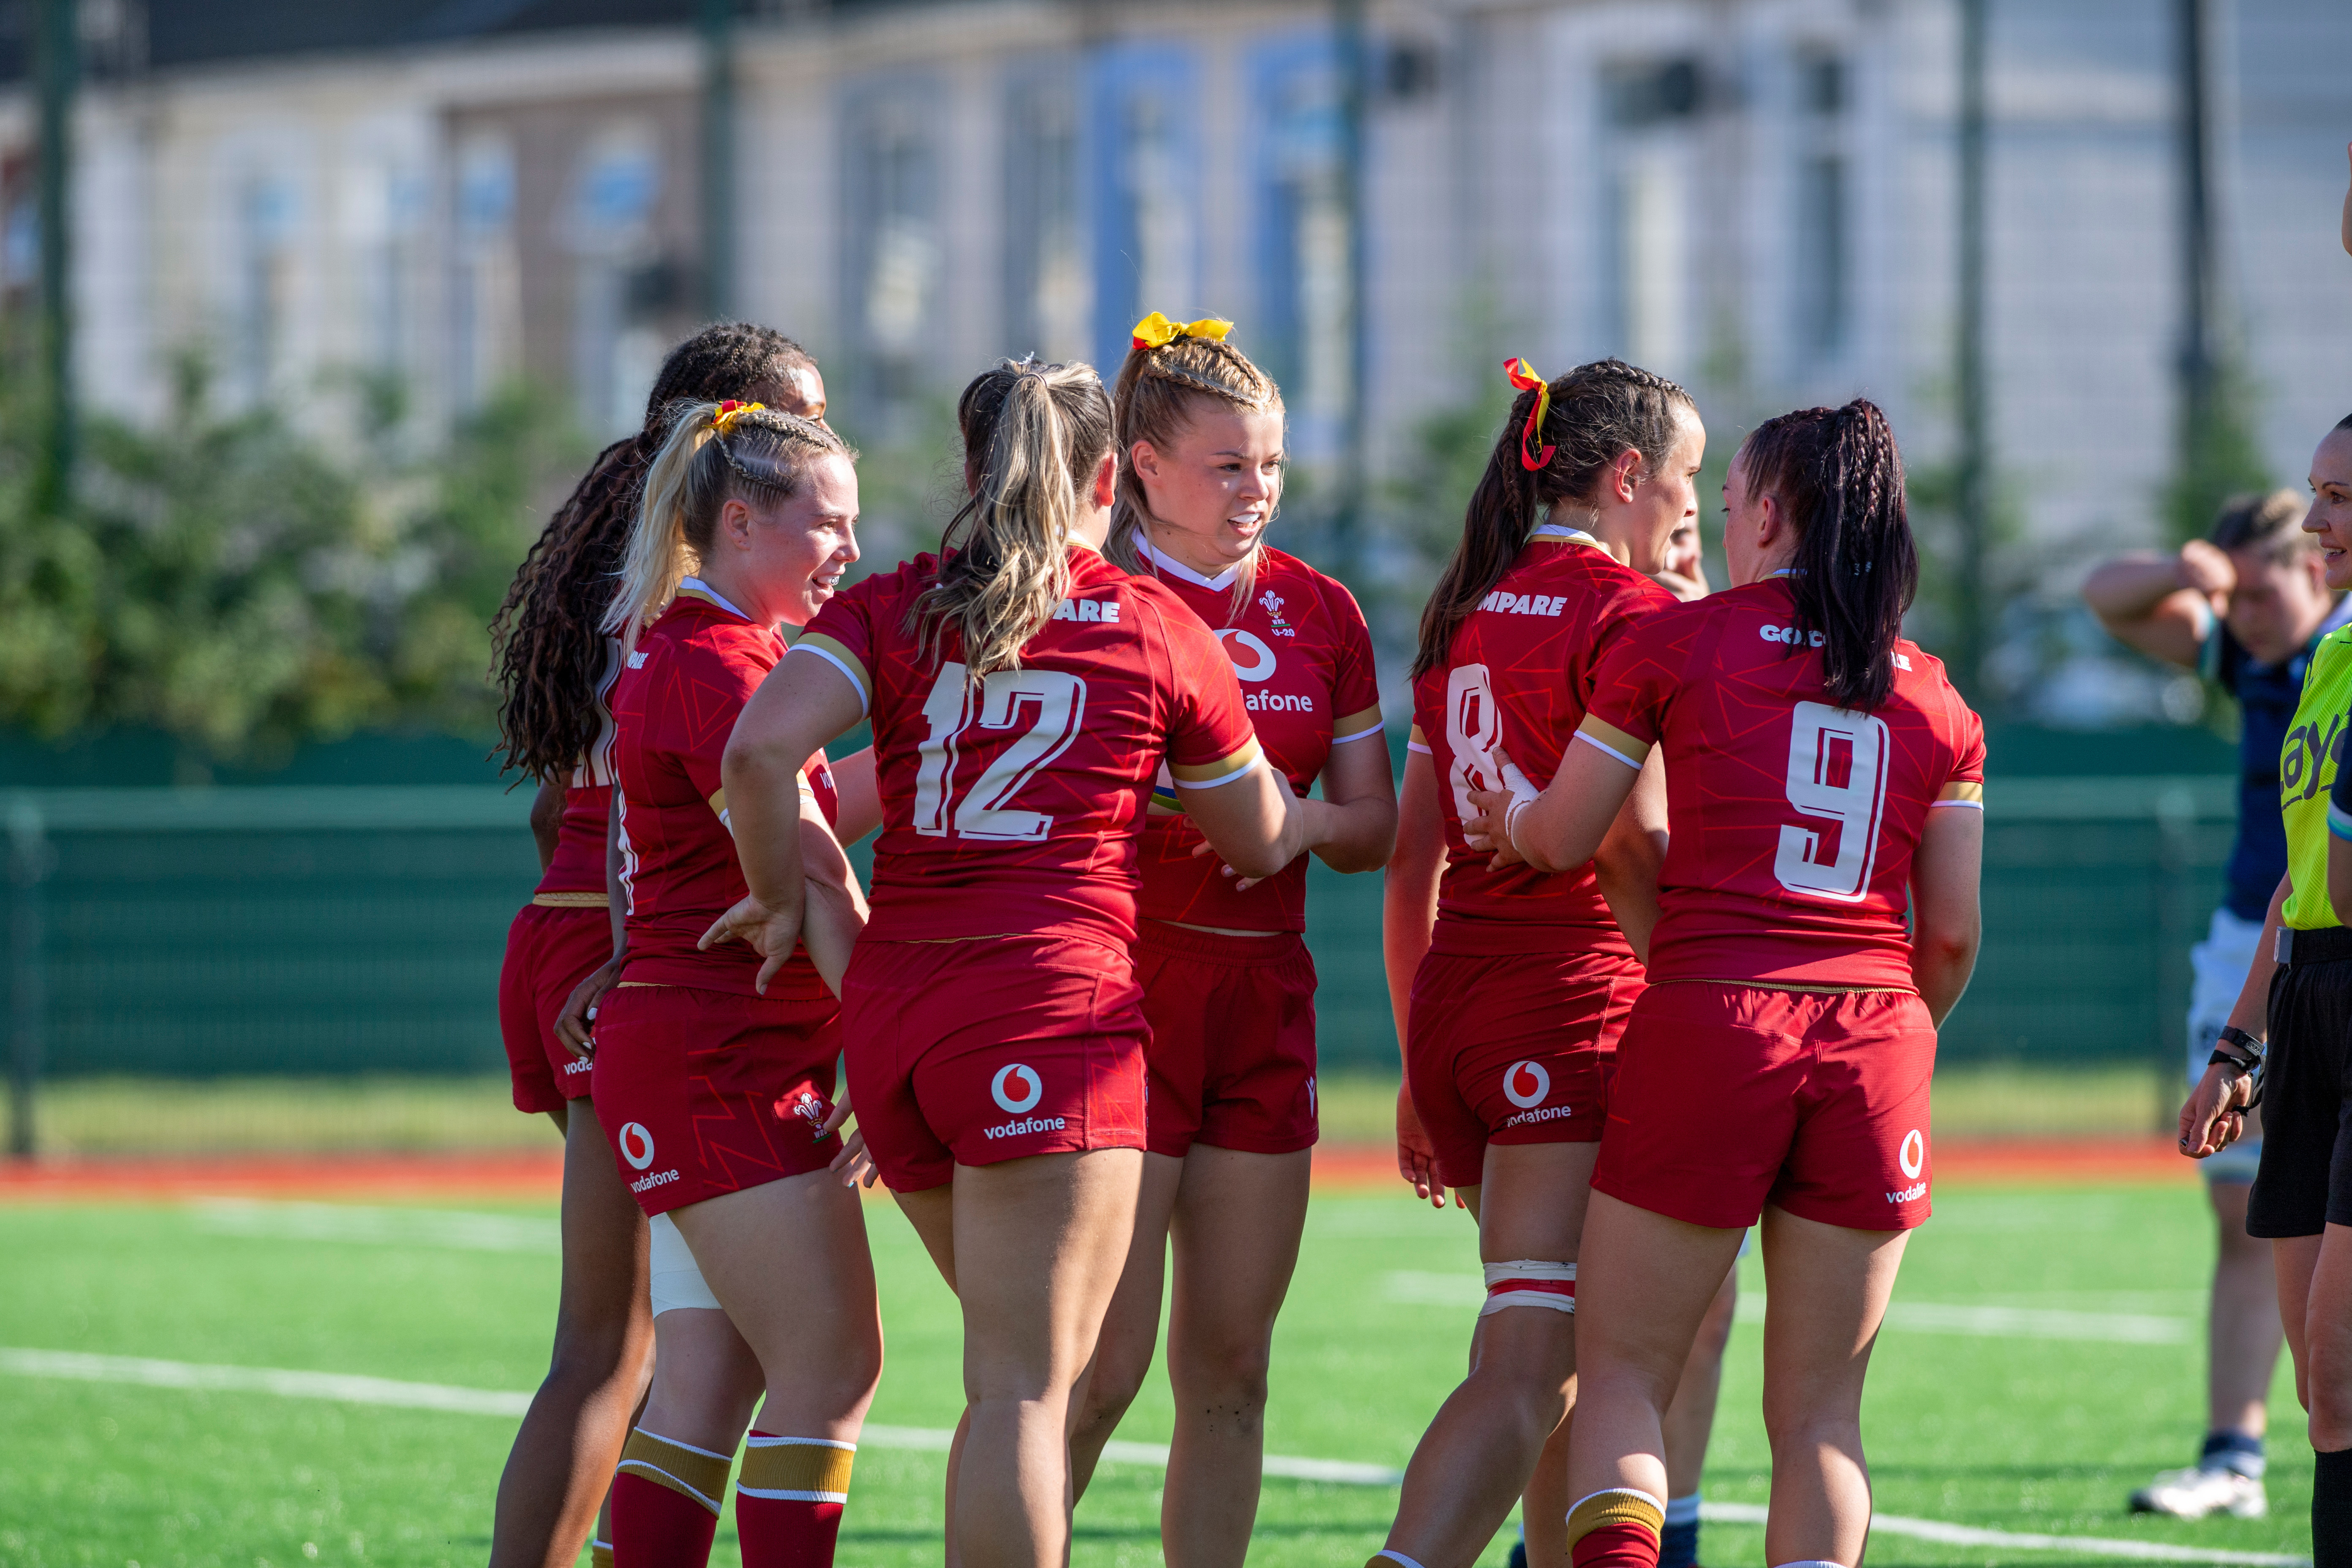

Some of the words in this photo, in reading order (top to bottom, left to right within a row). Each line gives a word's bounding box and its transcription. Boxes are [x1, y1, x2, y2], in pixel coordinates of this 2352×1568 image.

[1271, 628, 1295, 637] U-20
[1240, 689, 1313, 712] afone
[912, 661, 1087, 841] 12
[1446, 663, 1505, 847] 8
[2281, 713, 2349, 800] ay
[1774, 700, 1890, 903] 9
[983, 1117, 1065, 1140] vodafone
[630, 1169, 680, 1193] vodafone
[1886, 1182, 1926, 1203] vodafne
